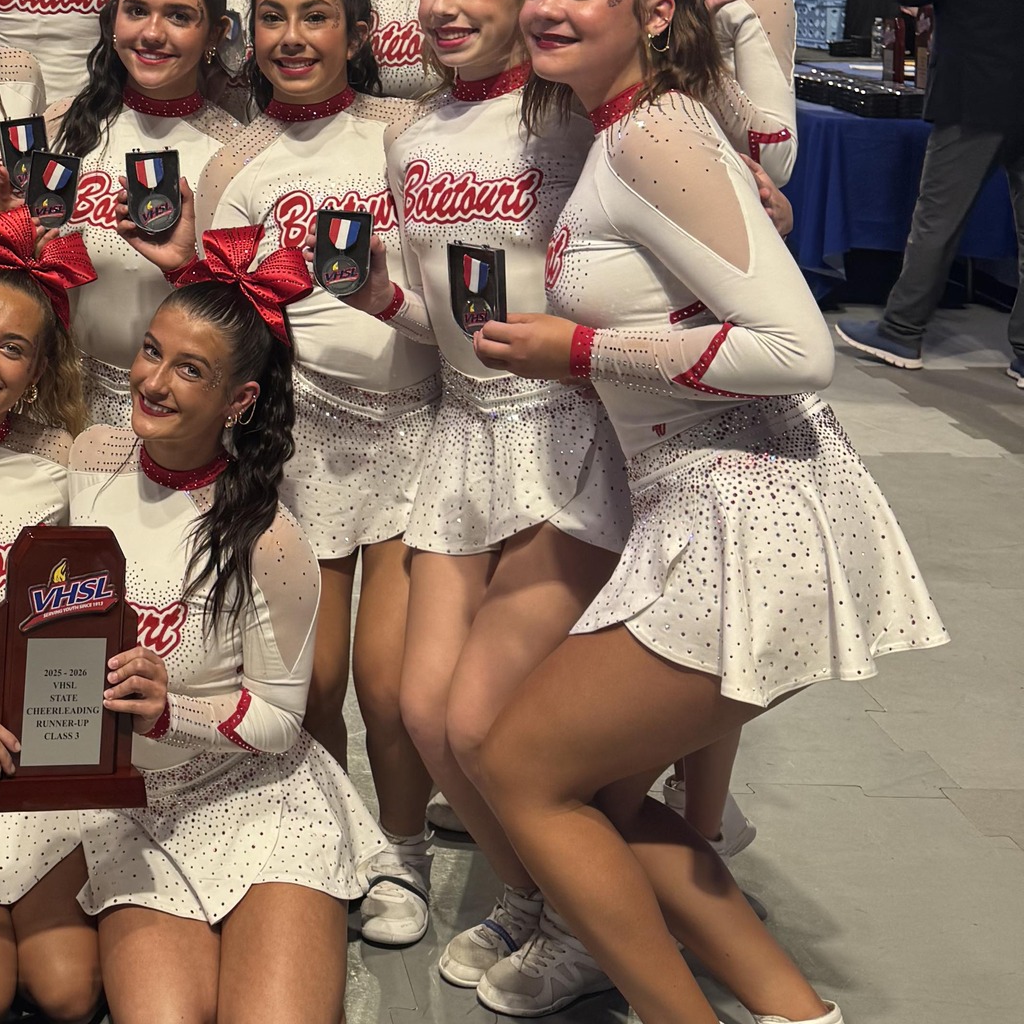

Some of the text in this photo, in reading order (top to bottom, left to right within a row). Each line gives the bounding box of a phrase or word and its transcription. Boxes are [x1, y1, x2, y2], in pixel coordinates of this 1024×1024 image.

[404, 159, 544, 224] Botetourt
[324, 266, 357, 281] VHSL
[32, 575, 113, 614] VHSL
[43, 609, 63, 618] SERVING
[44, 668, 87, 677] 2025 2026
[53, 681, 77, 689] VHSL
[49, 694, 78, 702] STATE
[26, 706, 100, 715] CHEERLEADING
[36, 719, 89, 728] RUNNER-UP
[44, 732, 80, 740] CLASS 3
